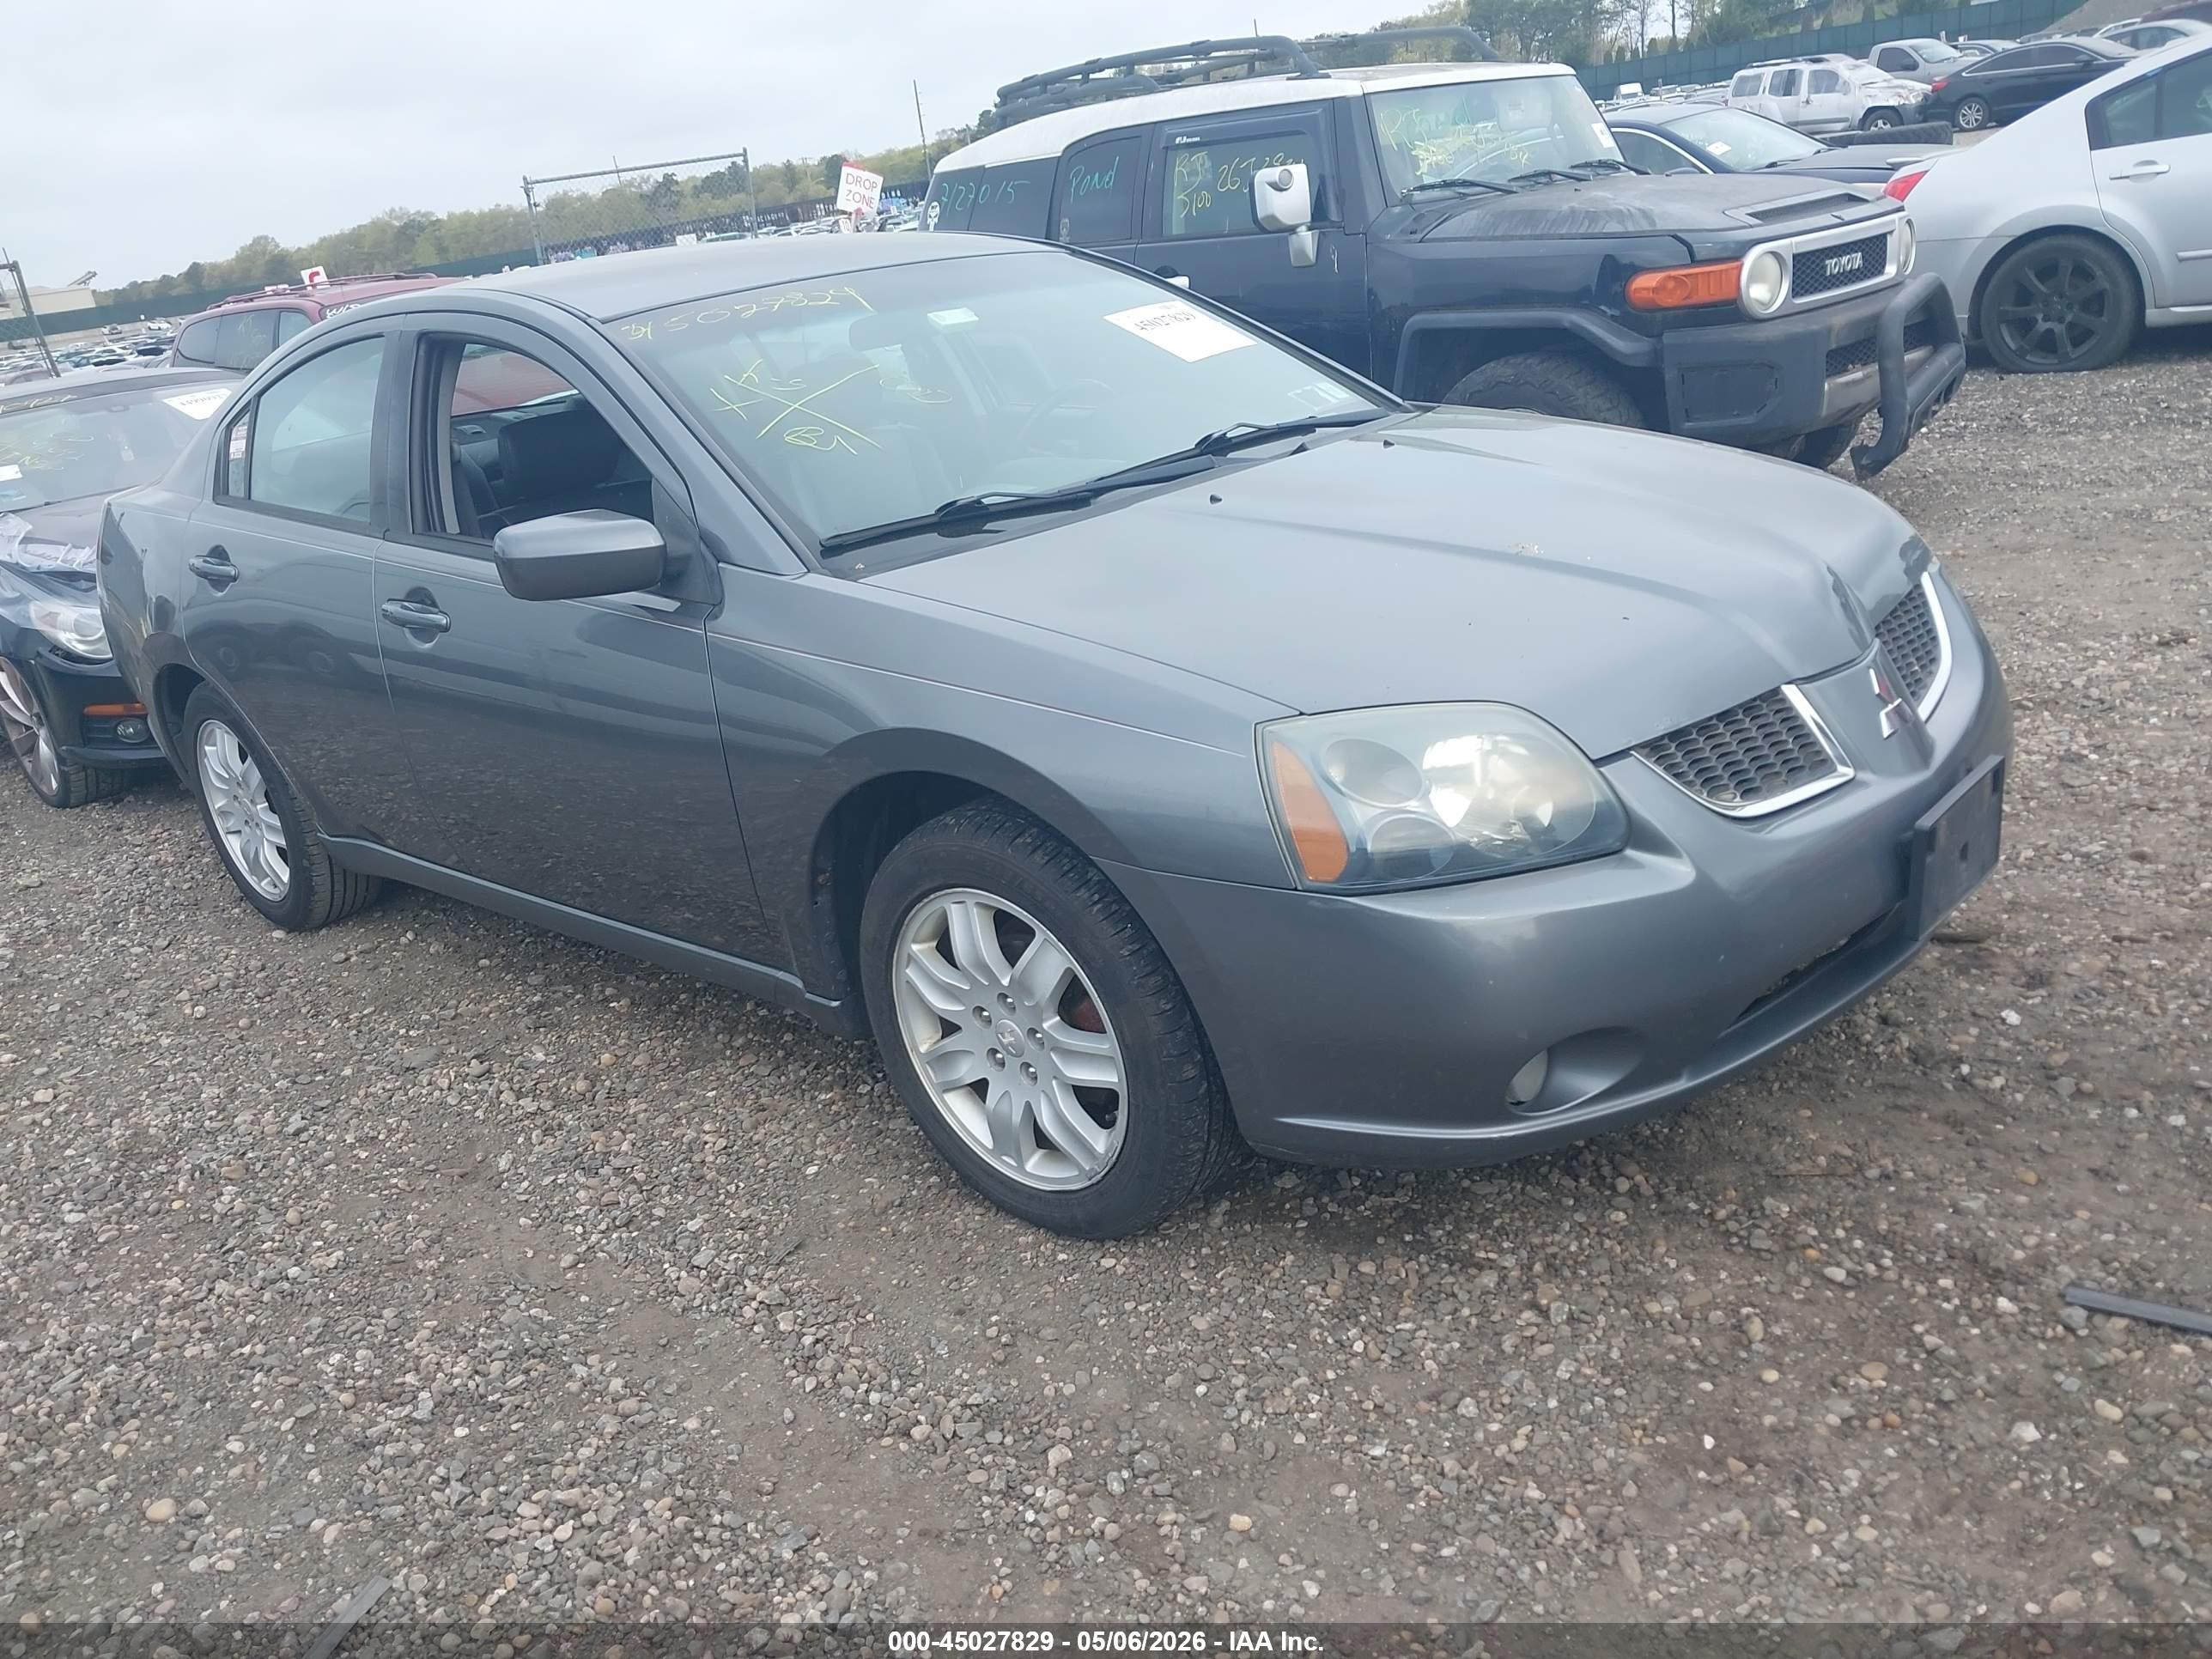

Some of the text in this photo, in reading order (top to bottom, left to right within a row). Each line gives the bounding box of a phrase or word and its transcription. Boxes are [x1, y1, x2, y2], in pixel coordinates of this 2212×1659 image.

[845, 173, 878, 191] DROP
[845, 189, 875, 210] ZONE
[1825, 252, 1863, 276] TOYOTA
